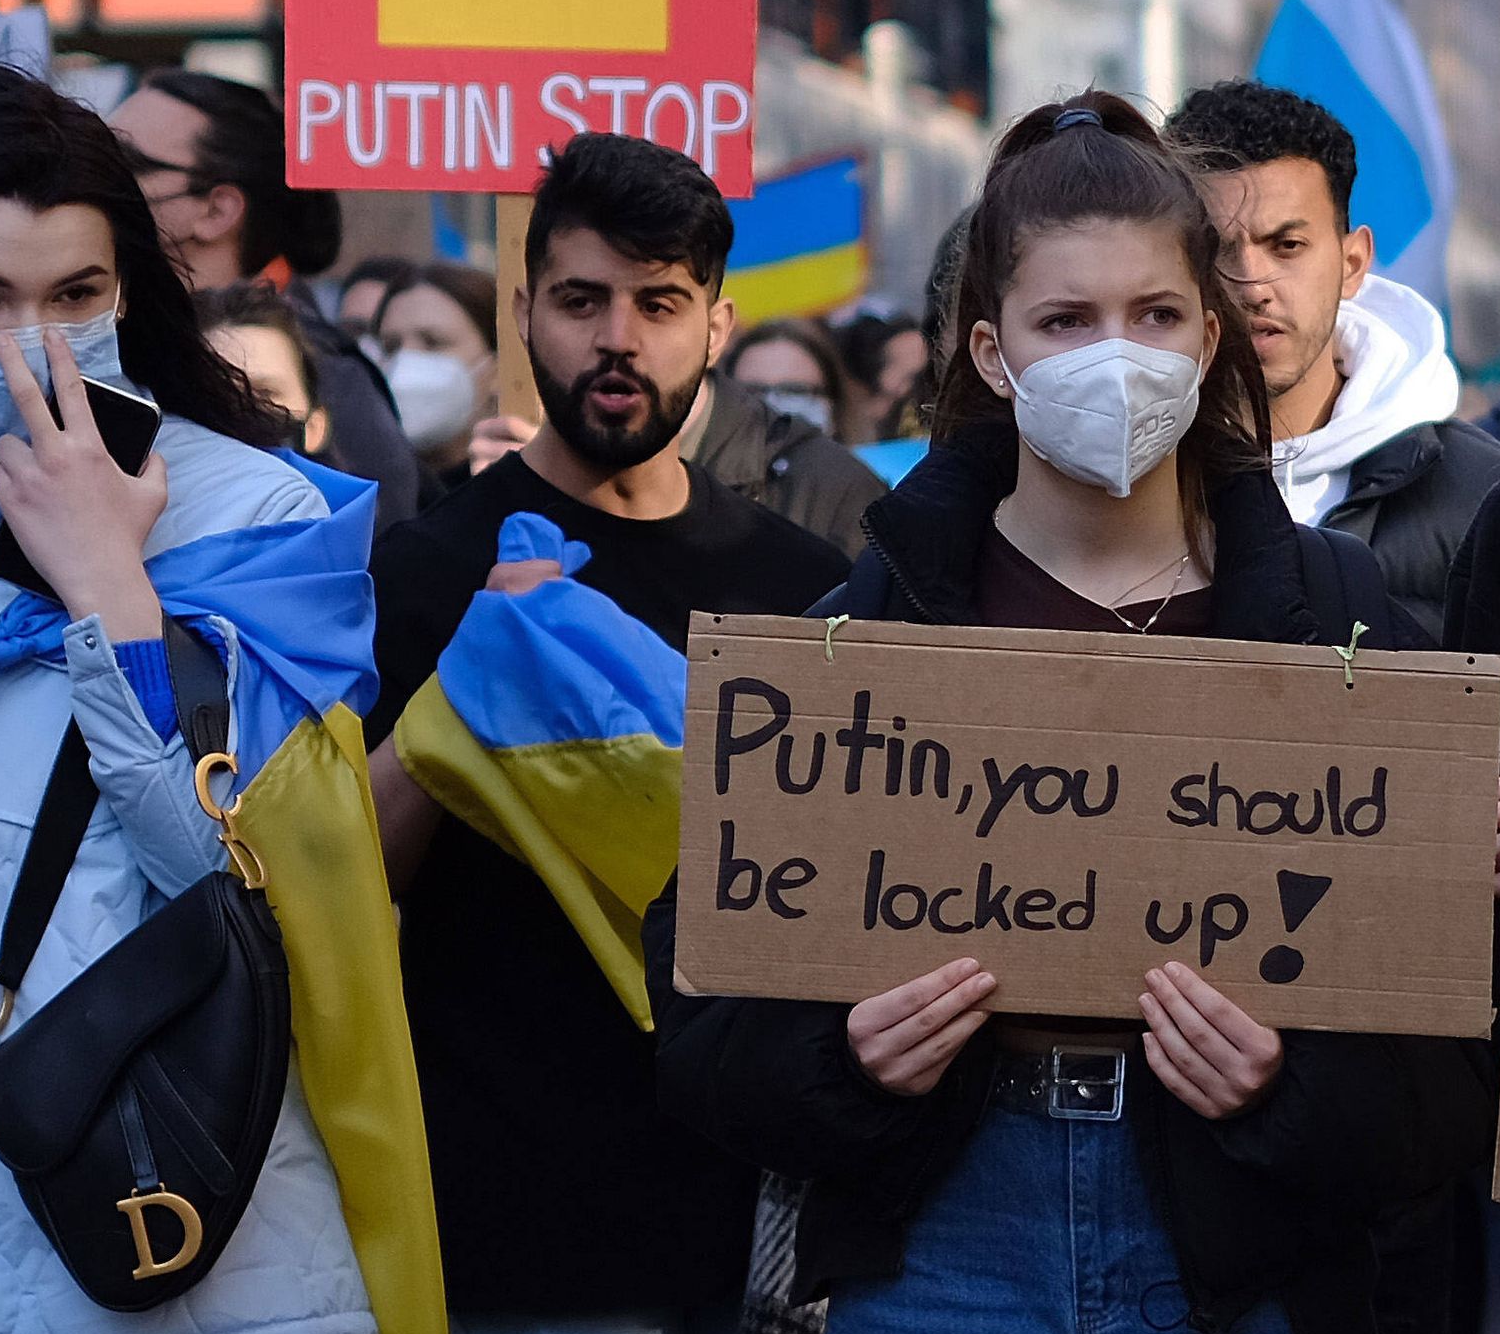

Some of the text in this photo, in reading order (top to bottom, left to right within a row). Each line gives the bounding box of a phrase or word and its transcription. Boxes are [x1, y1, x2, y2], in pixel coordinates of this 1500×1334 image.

[298, 71, 751, 176] PUTIN STOP
[1165, 760, 1389, 839] should
[715, 818, 819, 920] be
[862, 849, 1098, 935] locked
